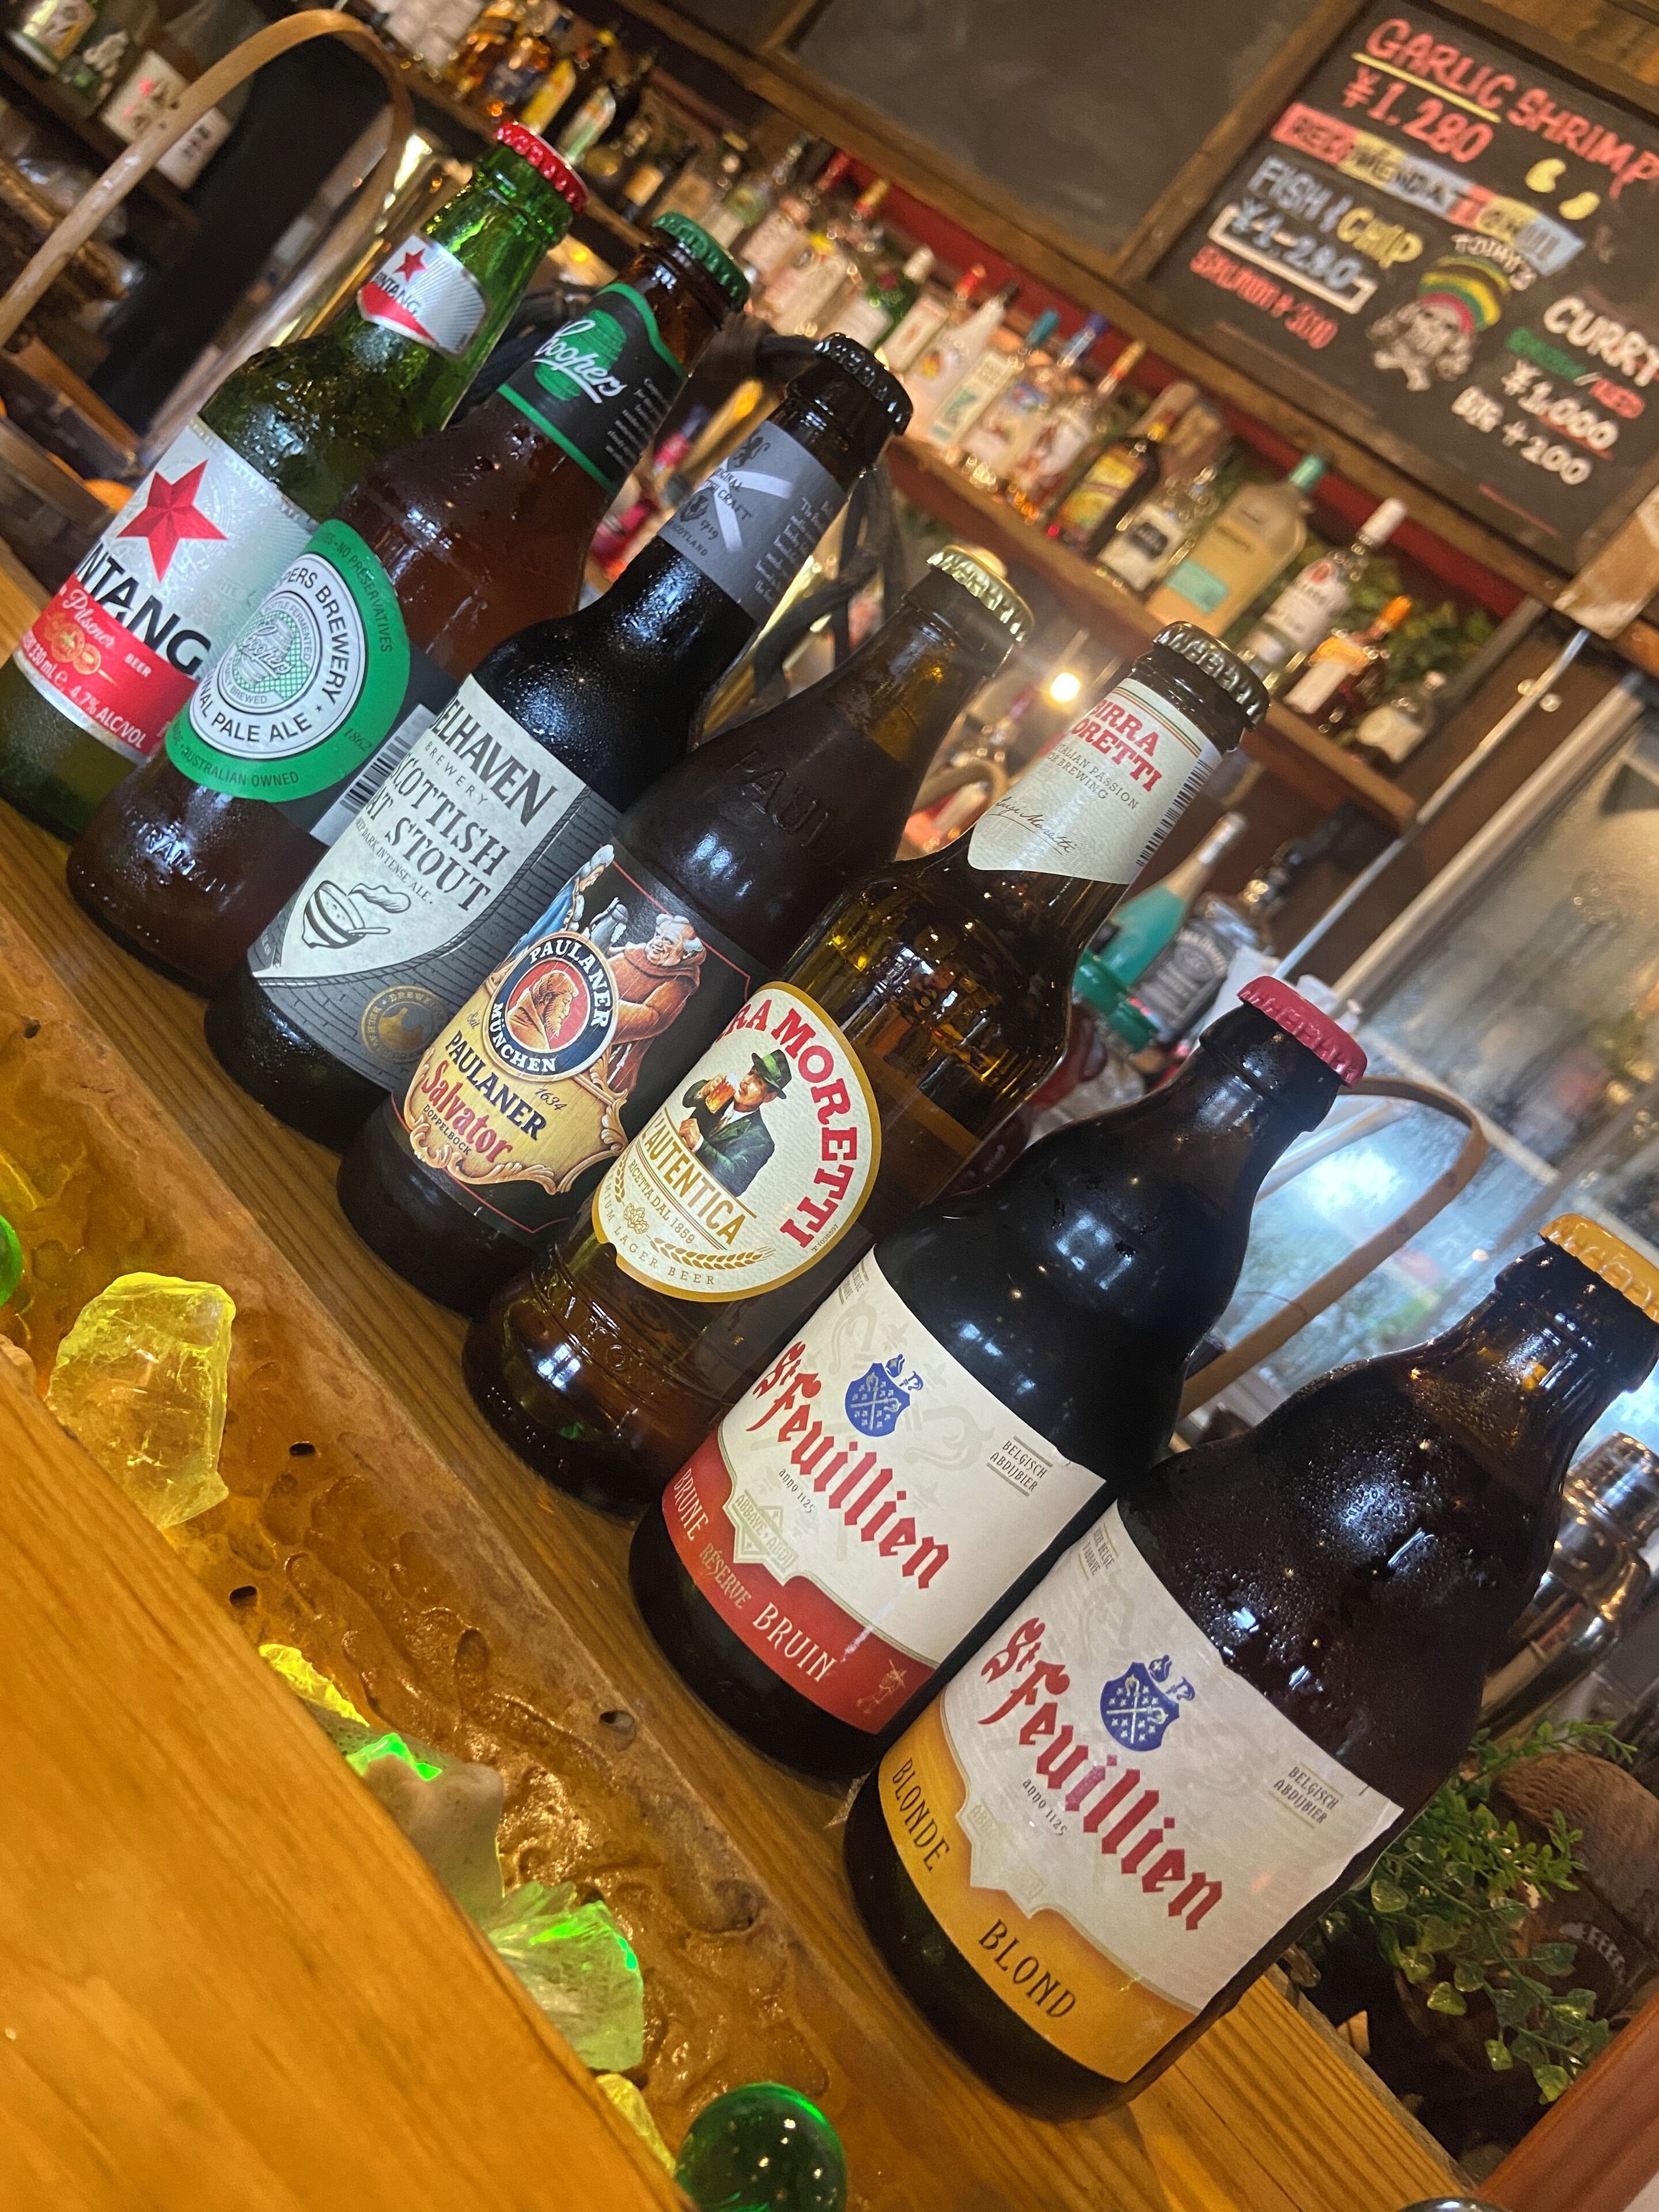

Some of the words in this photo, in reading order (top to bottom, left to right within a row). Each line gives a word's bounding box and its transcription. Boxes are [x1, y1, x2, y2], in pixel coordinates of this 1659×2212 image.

[1366, 18, 1516, 109] GARLIC
[1508, 88, 1659, 197] SHRIMP
[1247, 155, 1332, 221] FISH
[531, 320, 628, 403] Coopers
[1544, 294, 1659, 387] CURRY
[700, 520, 719, 540] 1719
[718, 490, 752, 520] CRAFT
[336, 541, 350, 561] NO
[349, 555, 393, 653] PRESERVATIVES
[289, 604, 312, 661] FERMENTED
[315, 585, 350, 704] BREWERY
[124, 654, 151, 677] BEER
[232, 685, 268, 704] BREWED
[70, 685, 100, 715] 4.7%
[95, 706, 147, 749] ALC/VOL
[211, 711, 260, 743] PALE
[269, 712, 312, 742] ALE
[344, 727, 373, 751] 1862
[180, 748, 247, 786] AUSTRALIAN
[251, 771, 299, 787] OWNED
[425, 741, 488, 805] BREWERY
[1057, 757, 1108, 799] BREWING
[1071, 718, 1162, 792] ORETTI
[1089, 767, 1139, 809] PASSION
[377, 847, 410, 882] INTENSE
[385, 817, 491, 911] STOUT
[530, 939, 611, 1027] PAULANER
[490, 1002, 556, 1072] MÜNCHEN
[421, 1059, 513, 1162] Salvator
[445, 1030, 547, 1141] PAULANER
[535, 1088, 567, 1111] 1634
[423, 1104, 472, 1156] DOPPELBOCK
[770, 1008, 858, 1249] MORETTI
[628, 1159, 654, 1198] RICETTA
[651, 1196, 670, 1221] DAL
[669, 1218, 695, 1244] 1859
[642, 1112, 745, 1245] L'AUTENTICA
[614, 1226, 658, 1268] LAGER
[668, 1267, 715, 1285] BEER
[988, 1450, 1039, 1493] ABDIJBIER
[1001, 1439, 1050, 1479] BELGISCH
[733, 1494, 766, 1538] ABBAYE
[778, 1468, 798, 1493] anno
[797, 1491, 817, 1514] 1125
[673, 1468, 709, 1541] BRUNE
[699, 1543, 751, 1609] RÉSERVE
[752, 1601, 837, 1683] BRUIN
[1097, 1541, 1115, 1569] BELGE
[1022, 1778, 1047, 1809] anno
[1046, 1809, 1068, 1836] 1125
[1272, 1778, 1328, 1825] ABDIJBIER
[1287, 1766, 1339, 1810] BELGISCH
[892, 1758, 952, 1872] BLONDE
[978, 1918, 1077, 2020] BLOND
